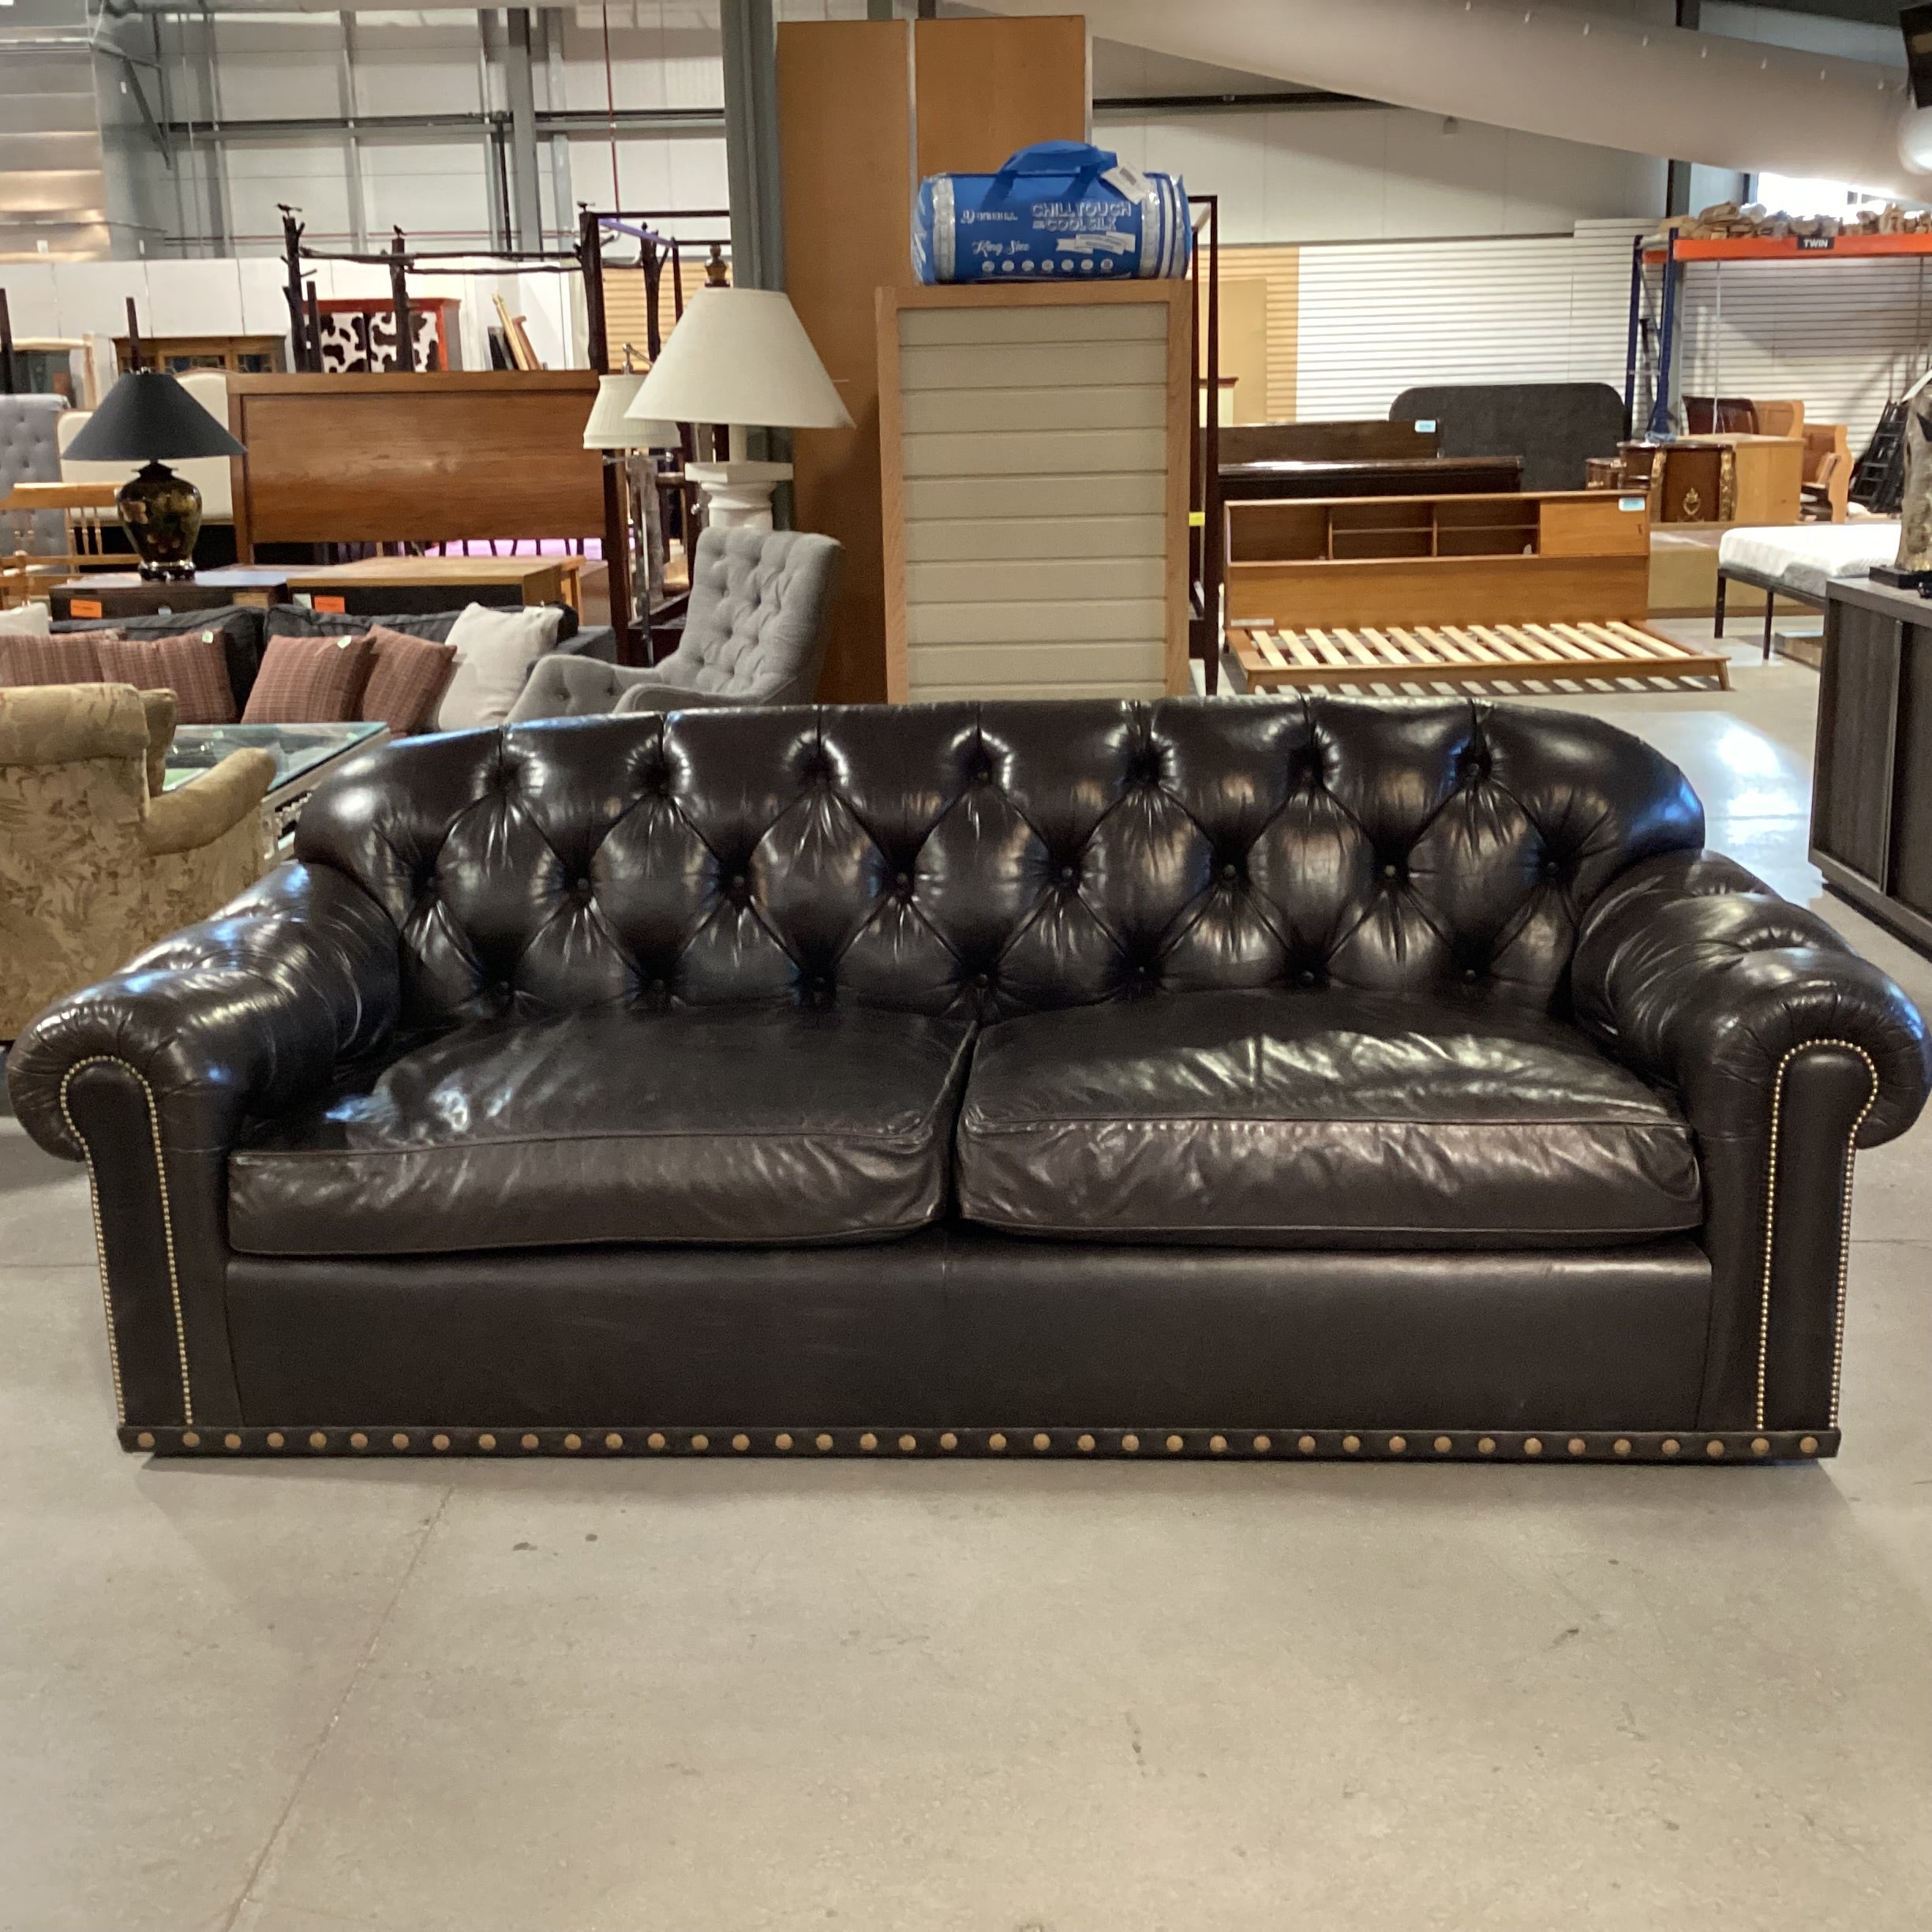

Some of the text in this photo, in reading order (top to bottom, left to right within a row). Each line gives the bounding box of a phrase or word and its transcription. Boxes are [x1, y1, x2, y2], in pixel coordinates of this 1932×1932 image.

[1032, 203, 1075, 218] CHILL
[1076, 201, 1132, 217] TOUCH
[1046, 217, 1087, 231] COOL
[972, 240, 1003, 257] King
[1803, 238, 1829, 249] TWIN
